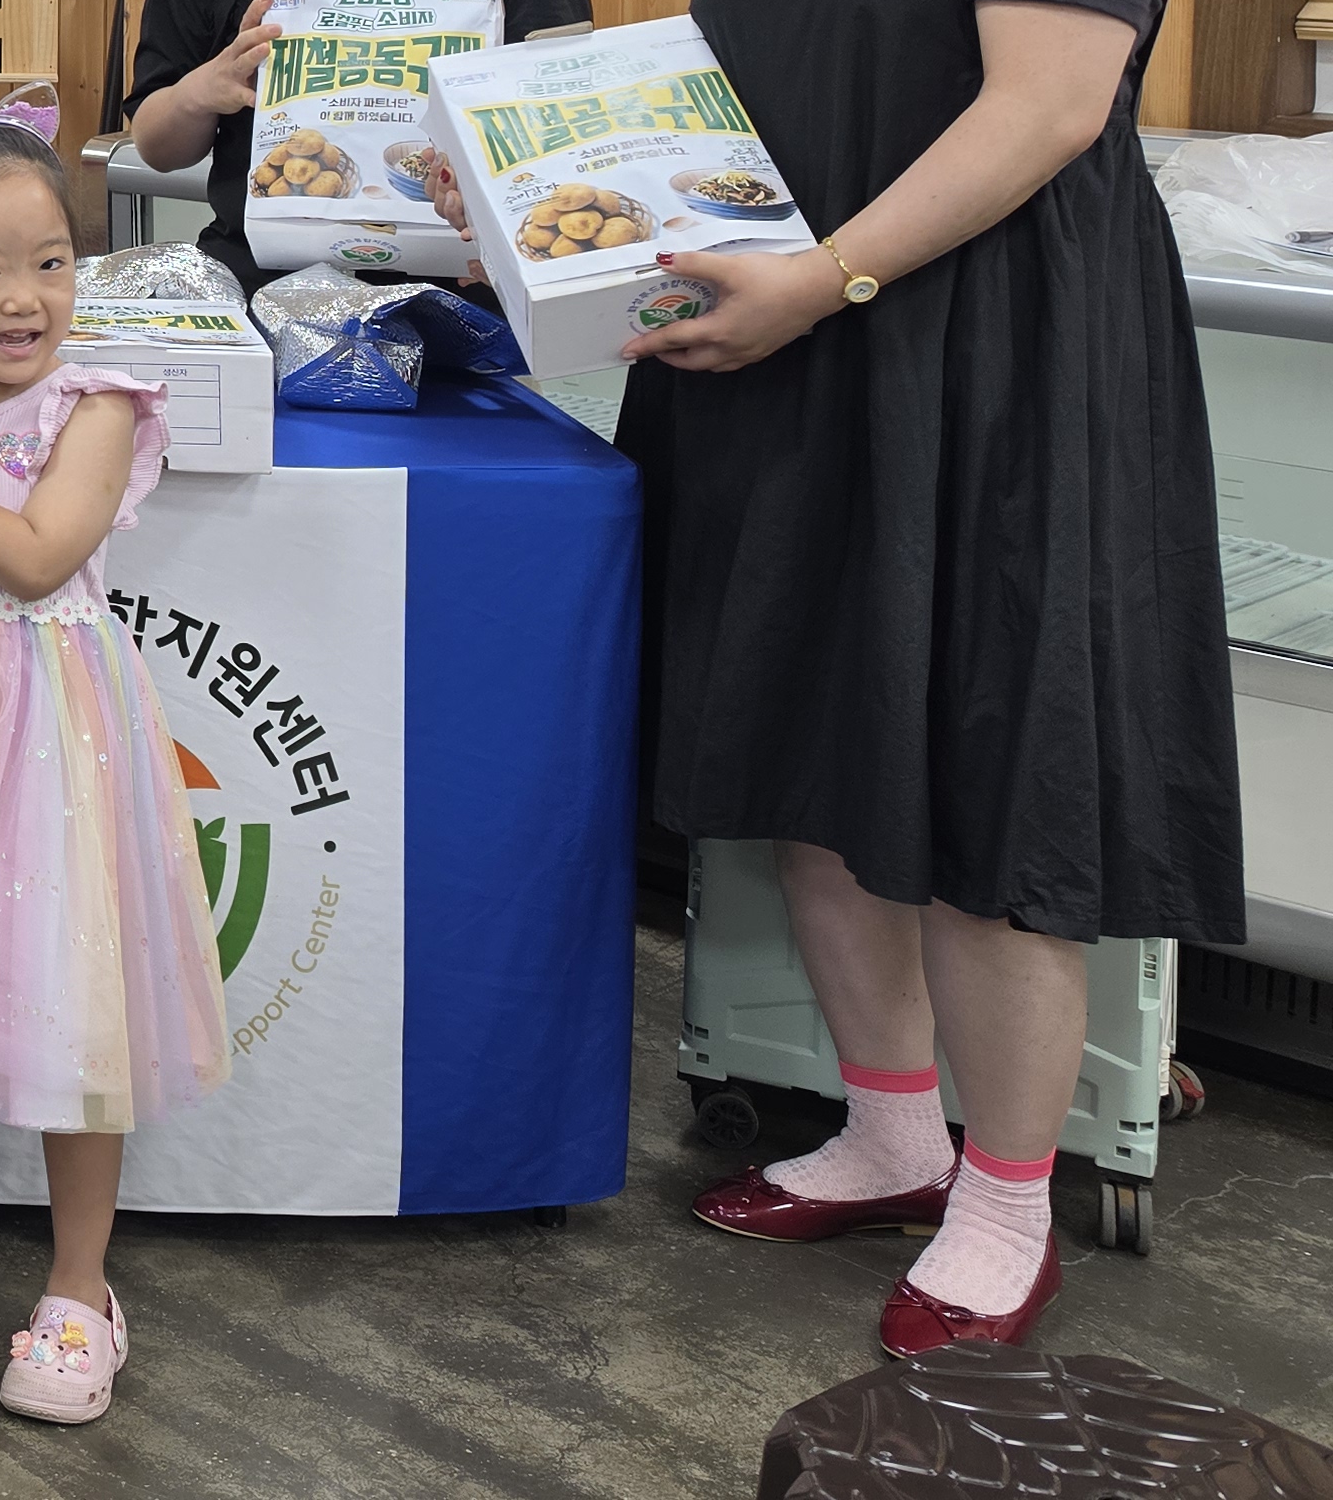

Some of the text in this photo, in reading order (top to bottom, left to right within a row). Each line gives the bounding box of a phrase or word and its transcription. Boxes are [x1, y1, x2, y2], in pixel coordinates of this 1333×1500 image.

[317, 11, 434, 30] 로컬푸드 소비자
[265, 35, 481, 106] 제철공동구
[470, 71, 752, 168] 제철공동구매
[232, 874, 340, 1056] pport Center
